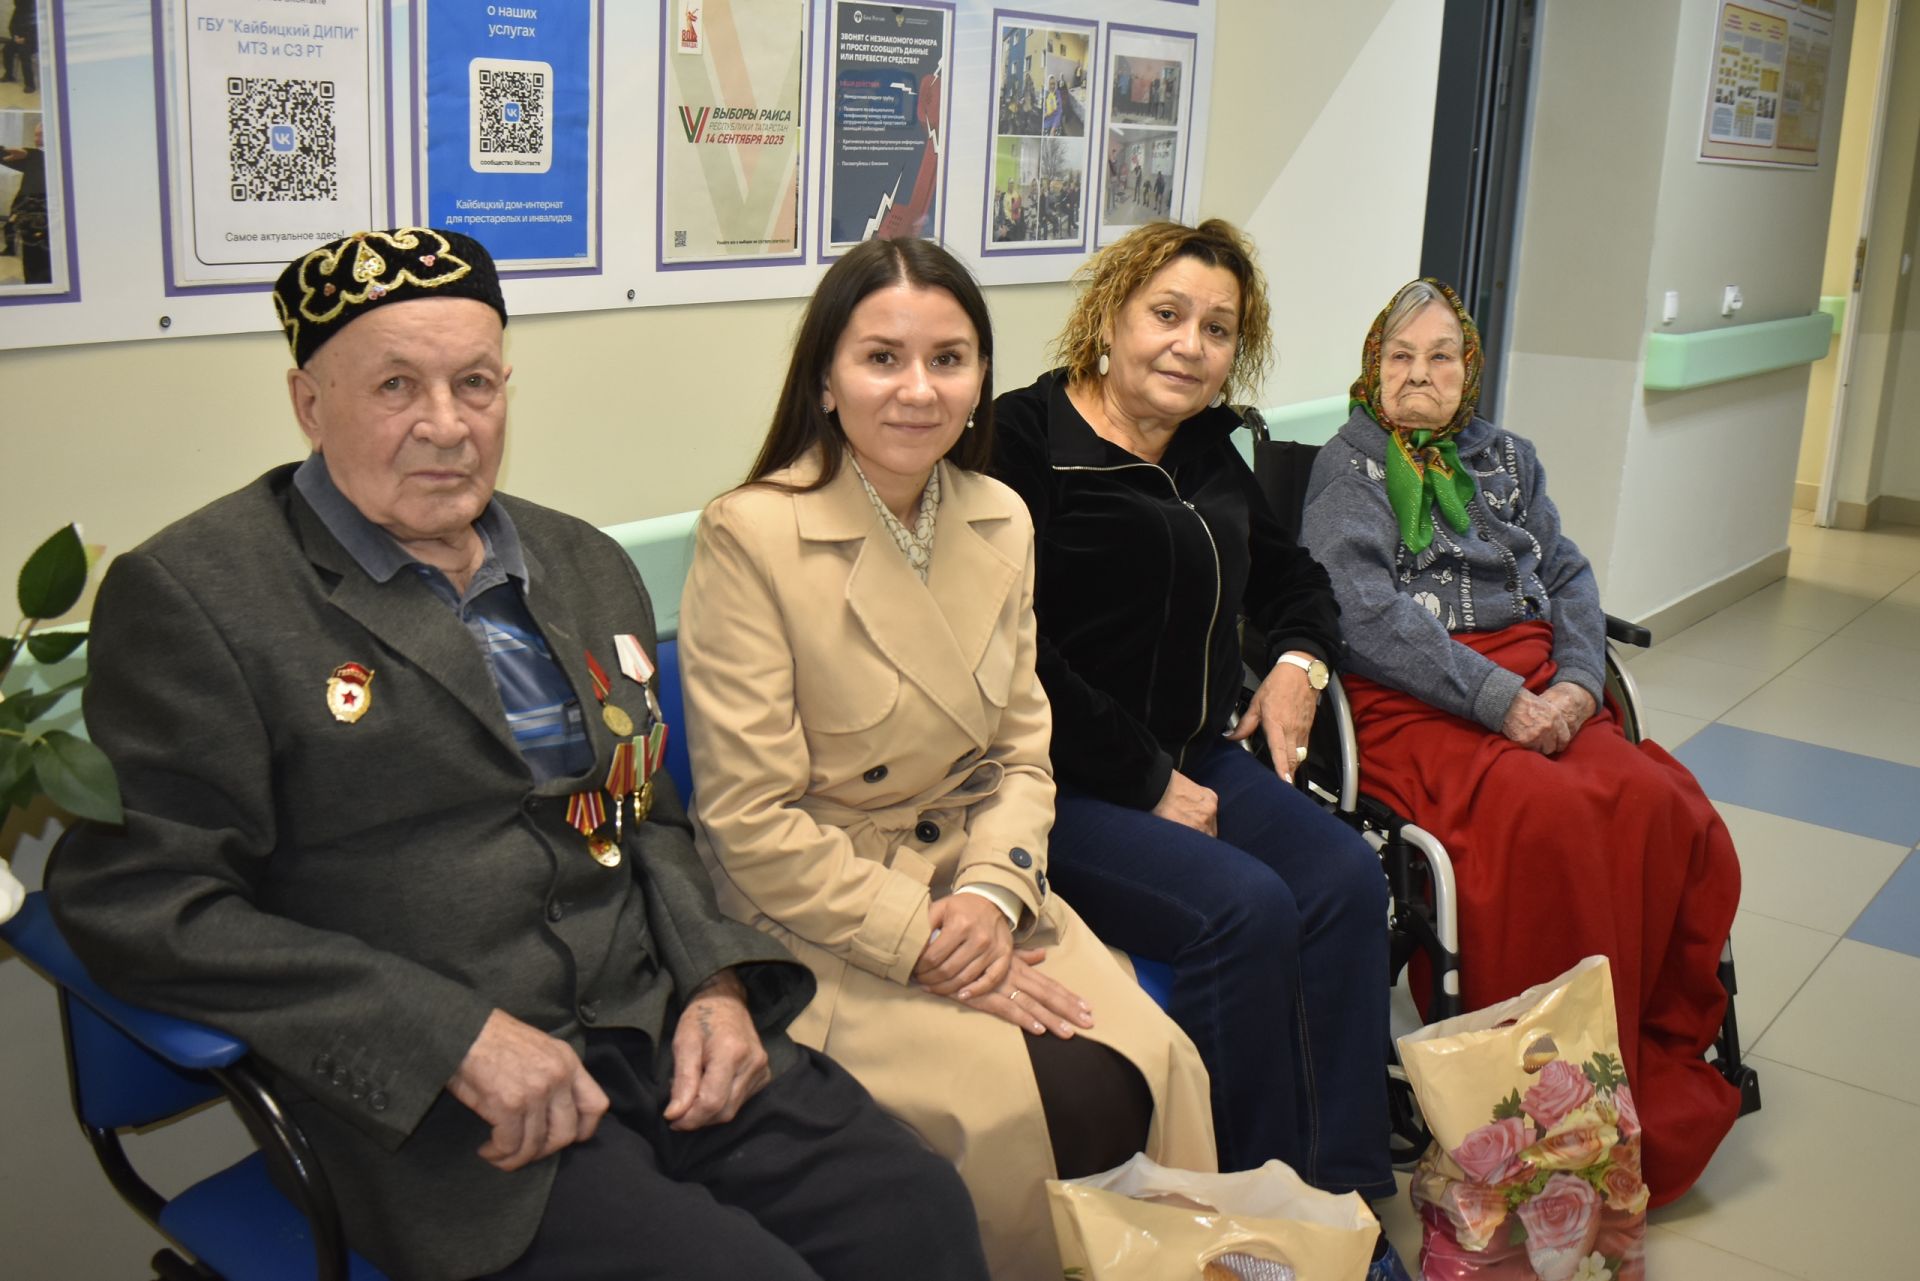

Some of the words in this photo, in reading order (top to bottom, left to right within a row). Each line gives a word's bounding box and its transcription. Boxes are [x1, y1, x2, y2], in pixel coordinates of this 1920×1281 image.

[487, 5, 496, 16] о
[498, 6, 537, 19] наших
[197, 16, 225, 32] ГБУ
[228, 19, 310, 37] "Кайбицкий
[488, 24, 536, 39] услугах
[840, 32, 865, 42] ЗВОНЯТ
[865, 34, 870, 42] С
[870, 34, 914, 45] НЕЗНАКОМОГО
[914, 37, 938, 47] НОМЕРА
[272, 45, 280, 56] и
[307, 45, 323, 58] РТ
[846, 43, 870, 52] ПРОСЯТ
[870, 44, 904, 54] СООБЩИТЬ
[904, 47, 929, 56] ДАННЫЕ
[840, 53, 854, 61] ИЛИ
[854, 53, 888, 63] ПЕРЕВЕСТИ
[888, 55, 920, 65] СРЕДСТВА?
[712, 107, 758, 121] ВЫБОРЫ
[760, 109, 792, 122] РАИСА
[708, 121, 754, 132] РЕСПУБЛИКИ
[754, 122, 789, 133] ТАТАРСТАН
[705, 133, 715, 144] 14
[717, 133, 763, 145] СЕНТЯБРЯ
[764, 134, 786, 145] 2025
[456, 199, 504, 210] Кайбицкий
[505, 200, 564, 211] дом-интернат
[446, 214, 463, 225] для
[464, 214, 521, 225] престарелых
[528, 213, 573, 224] инвалидов
[225, 232, 258, 242] Самое
[261, 231, 314, 243] актуальное
[316, 230, 345, 241] здесь!
